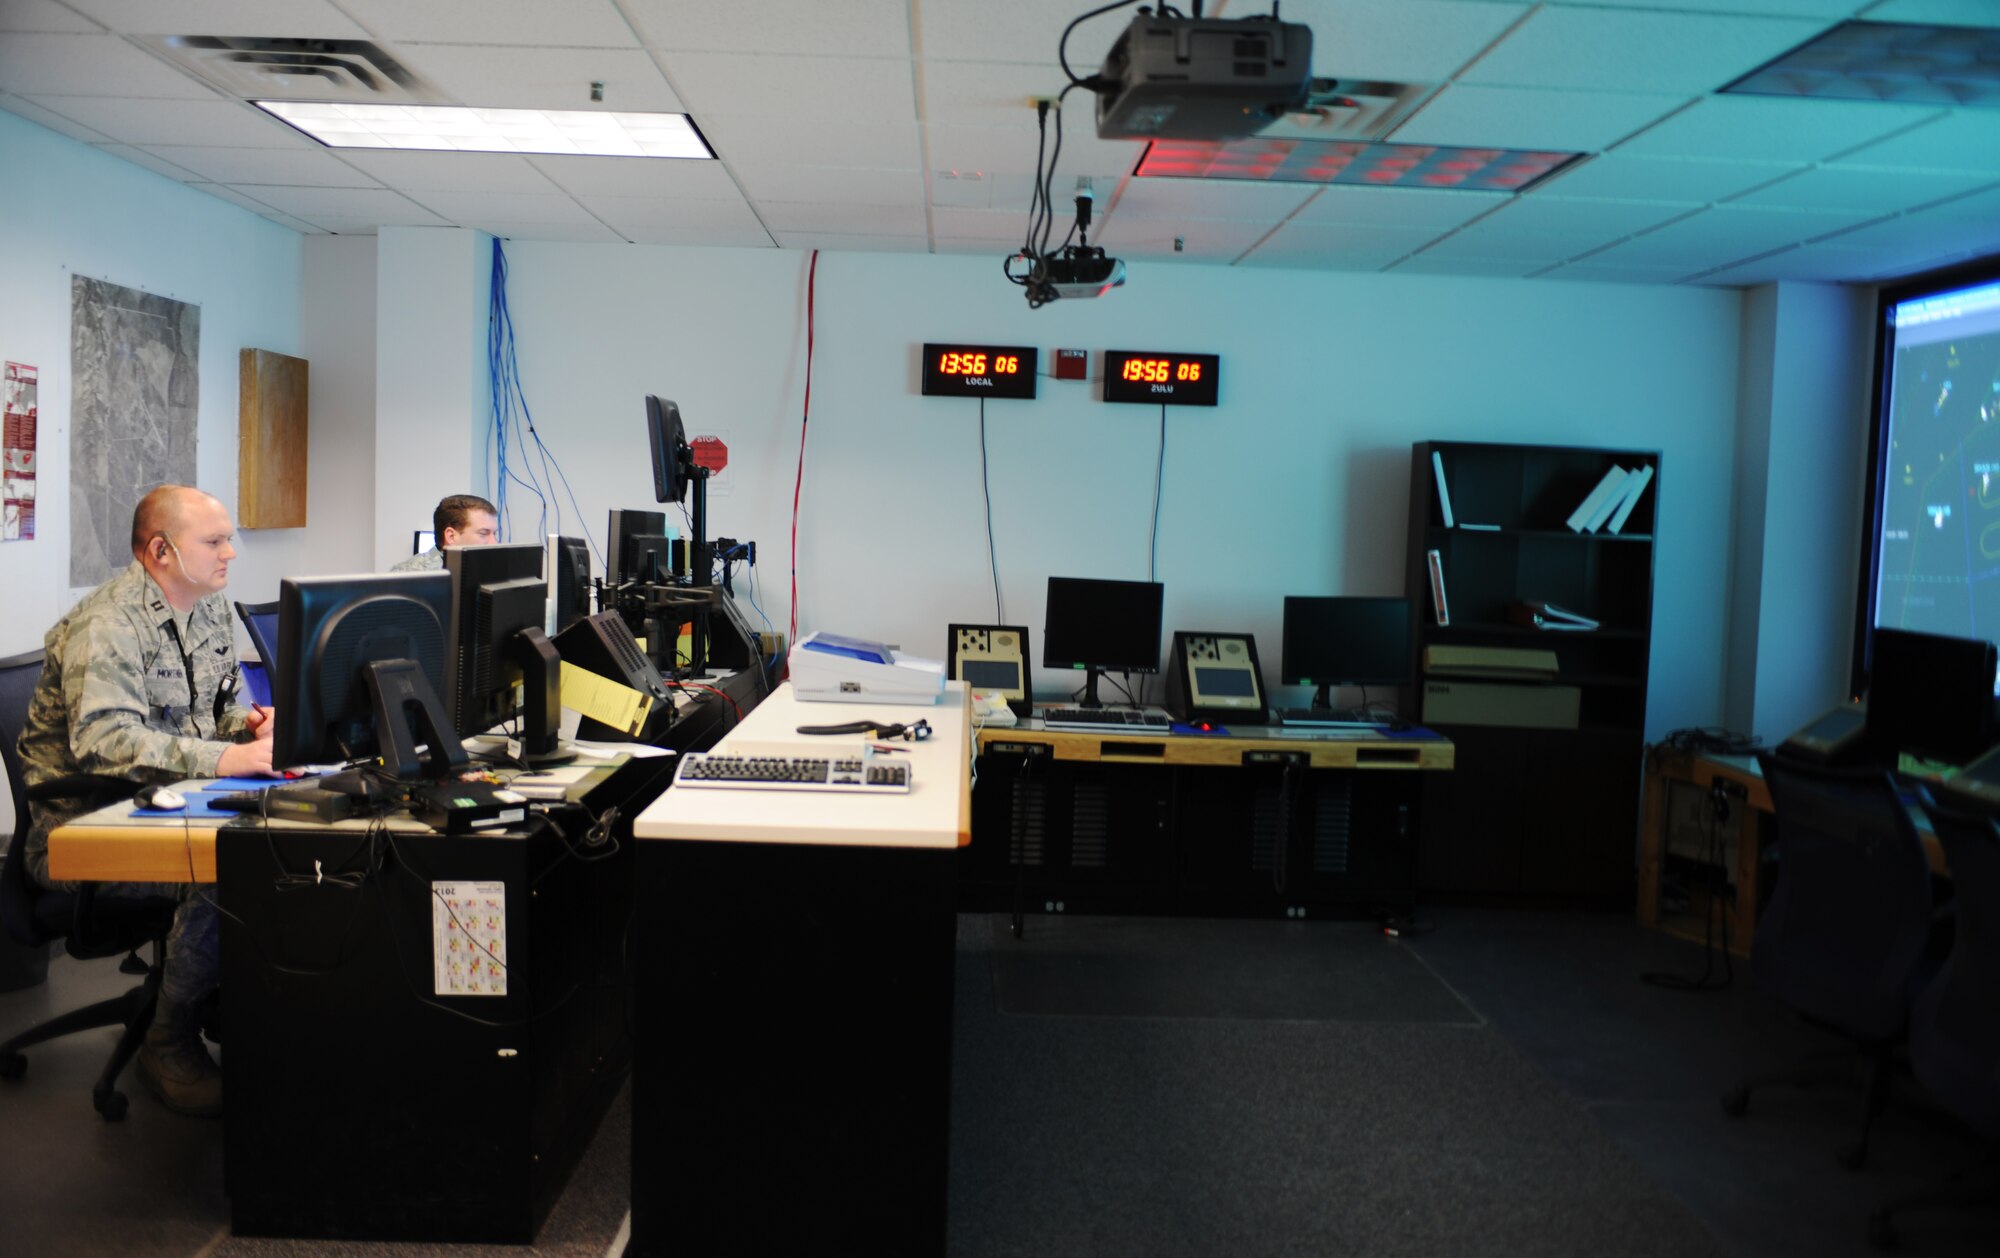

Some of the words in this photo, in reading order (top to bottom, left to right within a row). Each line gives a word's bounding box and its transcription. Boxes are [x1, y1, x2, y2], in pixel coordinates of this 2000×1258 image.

[940, 352, 987, 375] 13:56
[995, 355, 1018, 374] 06
[1122, 359, 1170, 382] 19:56
[1177, 362, 1201, 381] 06
[965, 377, 993, 387] LOCAL
